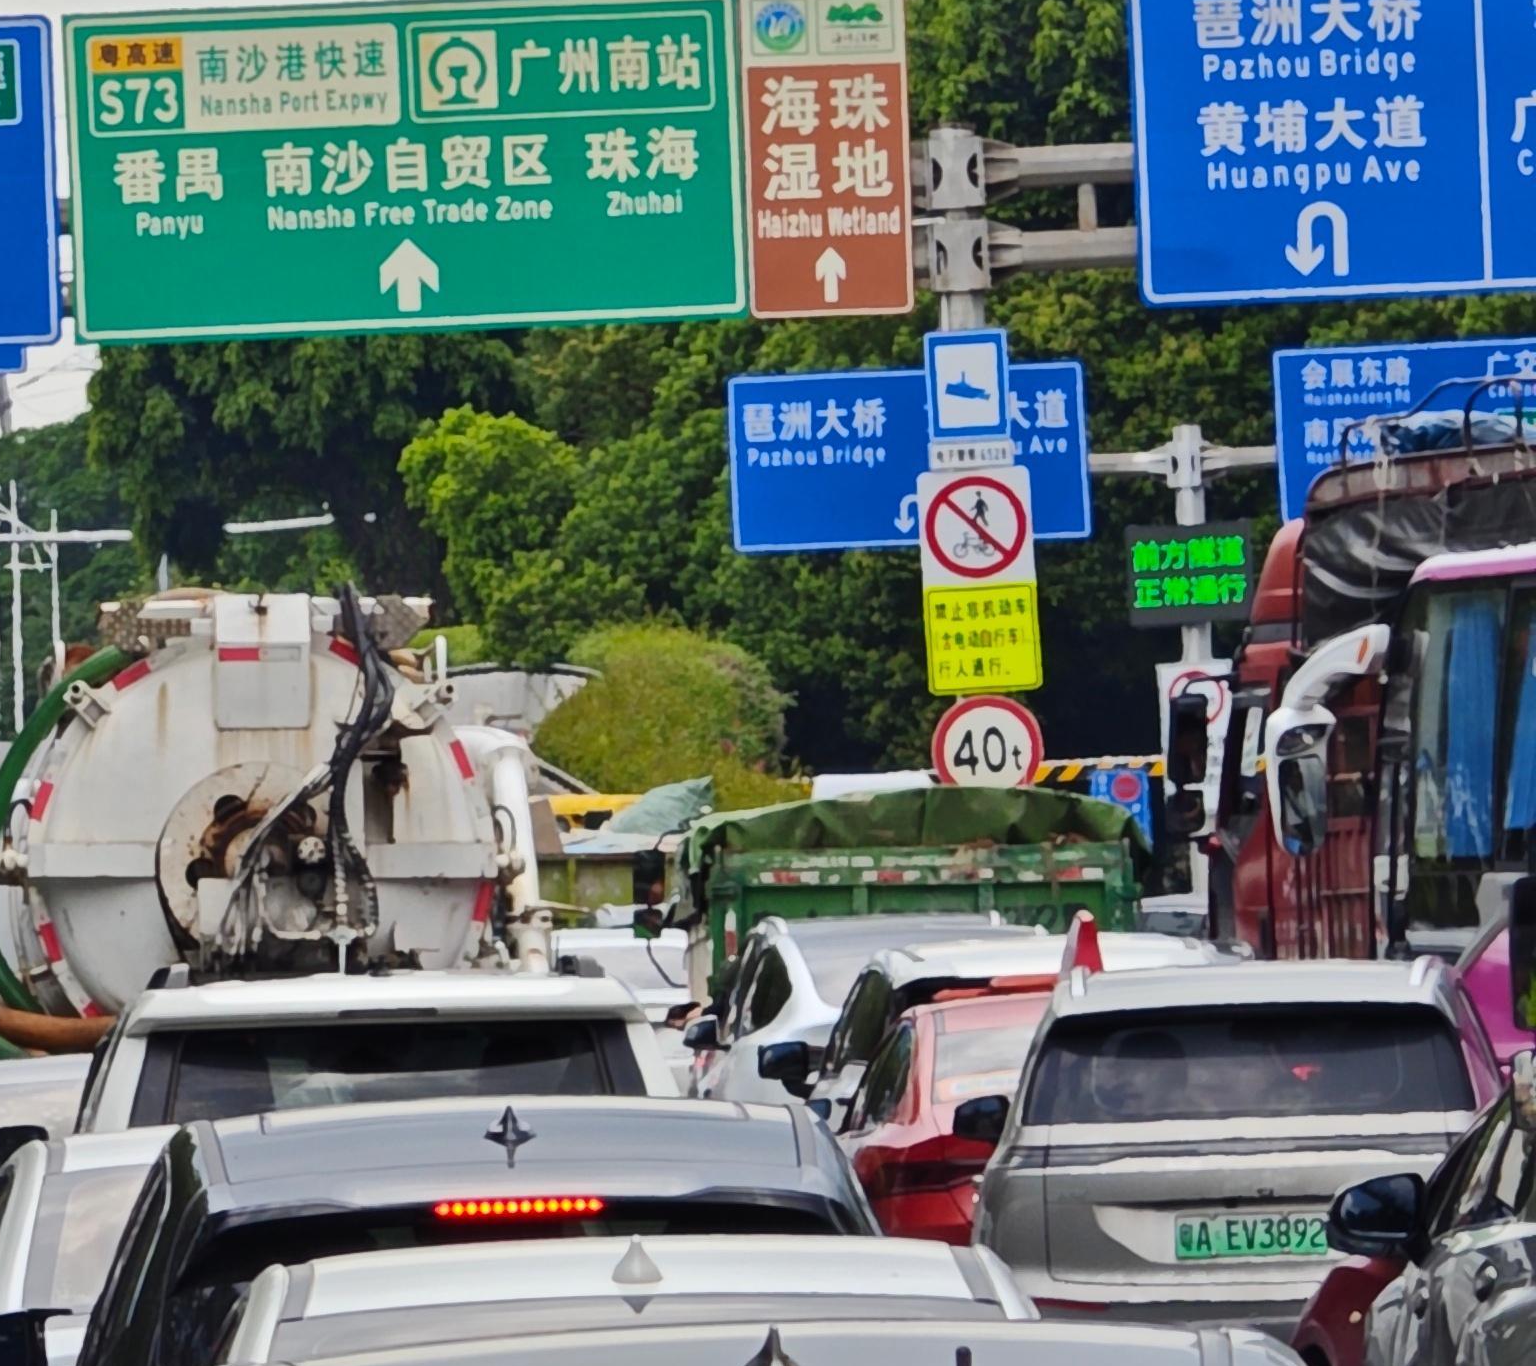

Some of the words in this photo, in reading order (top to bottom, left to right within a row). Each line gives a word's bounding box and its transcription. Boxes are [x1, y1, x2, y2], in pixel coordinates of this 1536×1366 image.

[98, 41, 176, 68] 粤高速
[195, 38, 387, 85] 南沙港快速
[509, 33, 702, 97] 广州南站
[1202, 51, 1311, 82] Pazhou
[1319, 48, 1416, 81] Bridge
[98, 76, 180, 126] S73
[200, 93, 272, 118] Nansha
[279, 90, 319, 115] Port
[326, 88, 388, 117] Expwy
[760, 73, 890, 136] 海珠
[1196, 94, 1427, 158] 黄埔大道
[113, 146, 224, 206] 番禺
[263, 133, 553, 198] 南沙自贸区
[585, 125, 700, 184] 珠海
[763, 138, 894, 201] 湿地
[1206, 160, 1352, 195] Huangpu
[1362, 155, 1421, 184] Ave
[267, 202, 356, 232] Nansha
[364, 200, 416, 226] Free
[425, 198, 488, 224] Trade
[495, 196, 553, 221] Zone
[605, 189, 684, 218] Zhuhai
[757, 207, 823, 239] Haizhu
[827, 205, 901, 236] Wetland
[136, 210, 204, 241] Panyu
[742, 397, 887, 443] 琶洲大桥
[747, 447, 818, 468] Pazhou
[822, 445, 887, 469] Bridge
[1133, 573, 1247, 609] 正常通行
